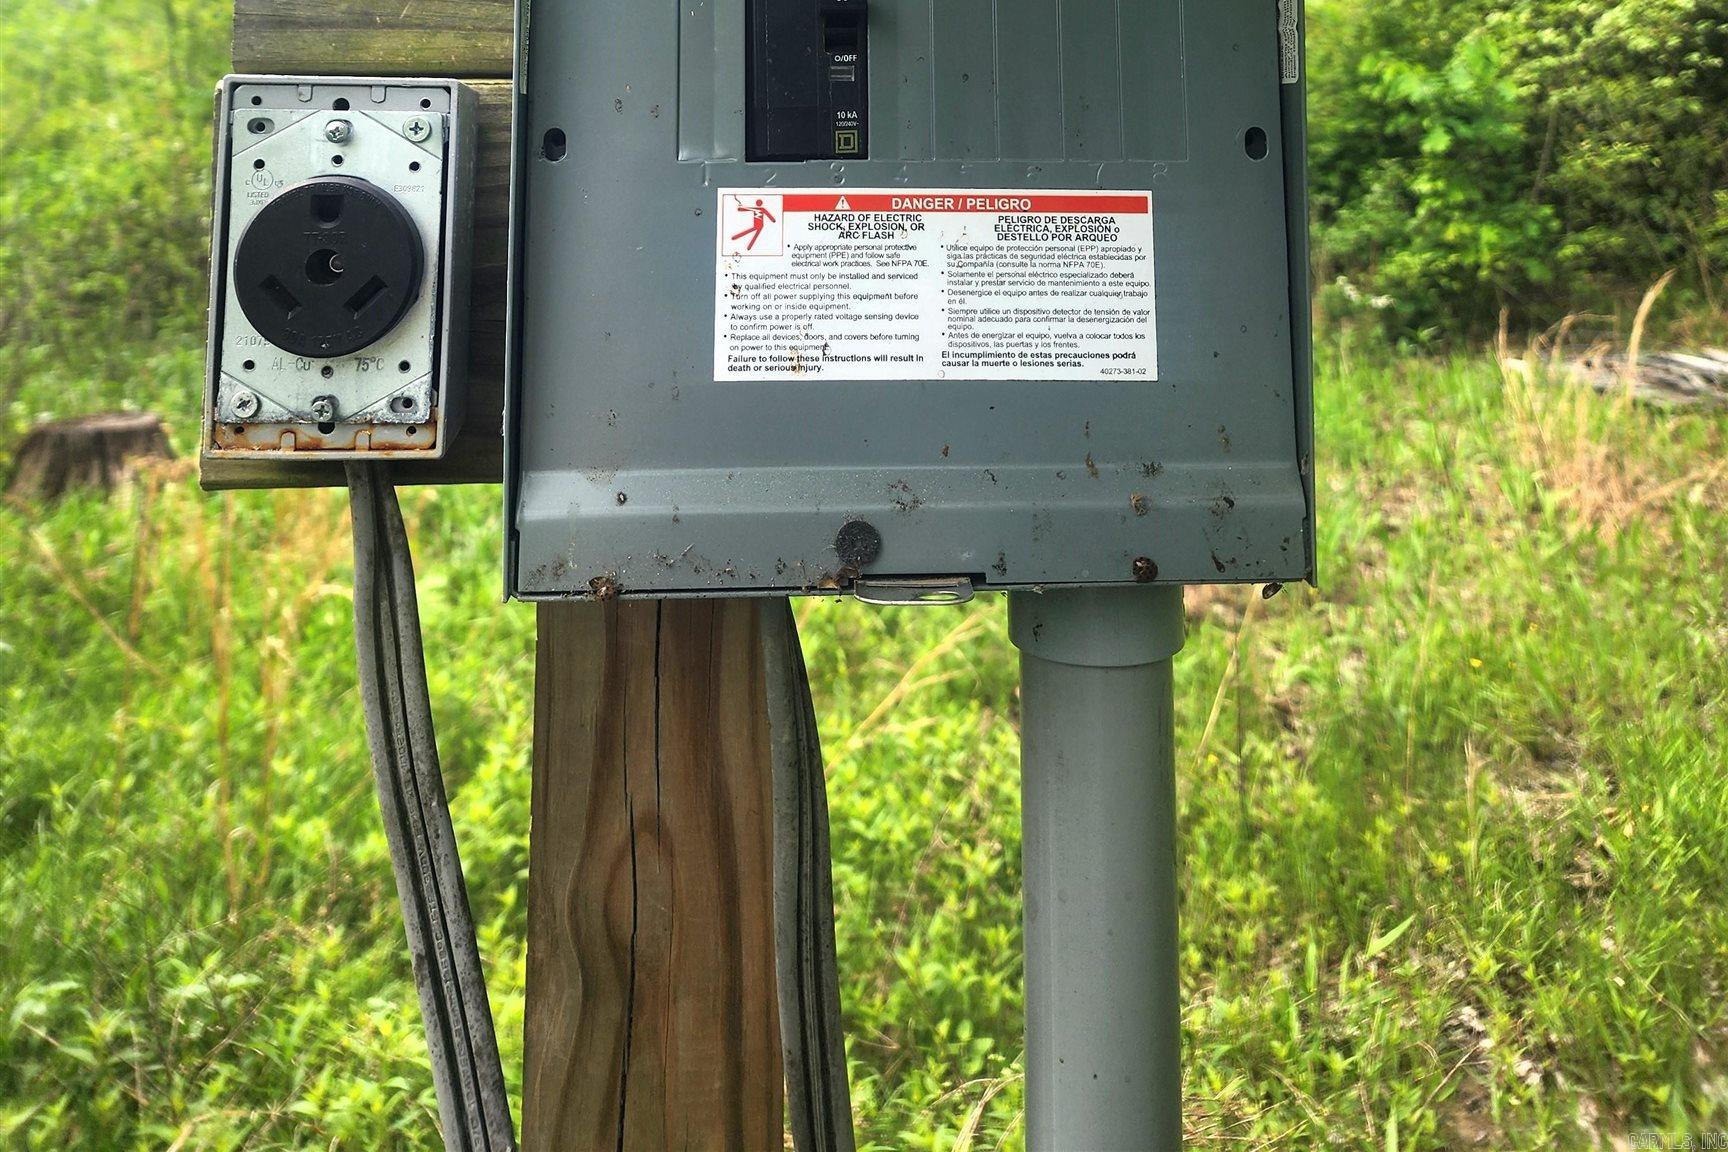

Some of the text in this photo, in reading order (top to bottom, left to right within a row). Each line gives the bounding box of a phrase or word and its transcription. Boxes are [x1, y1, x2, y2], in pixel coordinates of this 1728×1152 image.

[837, 111, 858, 119] 10 kA
[892, 197, 954, 209] DANGER
[966, 198, 1031, 211] PELIGRO
[814, 214, 922, 222] HAZARD OF ELECTRIC
[998, 216, 1116, 224] PELIGRO DE DESCARGA
[808, 222, 925, 232] SHOCK, EXPLOSION, OR
[994, 224, 1120, 233] ELÉCTRICA, EXPLOSIÓN o
[1075, 234, 1118, 242] ARQUEO
[794, 244, 813, 252] Apply
[814, 244, 852, 252] appropriate
[884, 244, 917, 252] protective
[749, 273, 788, 281] equipment
[810, 273, 825, 281] only
[799, 293, 835, 301] supplying
[852, 293, 892, 301] equipment
[809, 303, 851, 311] equipment.
[948, 308, 978, 316] Siempre
[1012, 308, 1051, 316] dispositivo
[1052, 308, 1081, 316] detector
[782, 313, 812, 321] properly
[864, 313, 893, 321] sensing
[730, 334, 760, 342] Replace
[796, 355, 820, 363] these
[952, 351, 1016, 359] incumplimiento
[1112, 352, 1136, 360] podrá
[728, 364, 751, 372] death
[764, 364, 797, 372] serious
[797, 364, 824, 372] injury.
